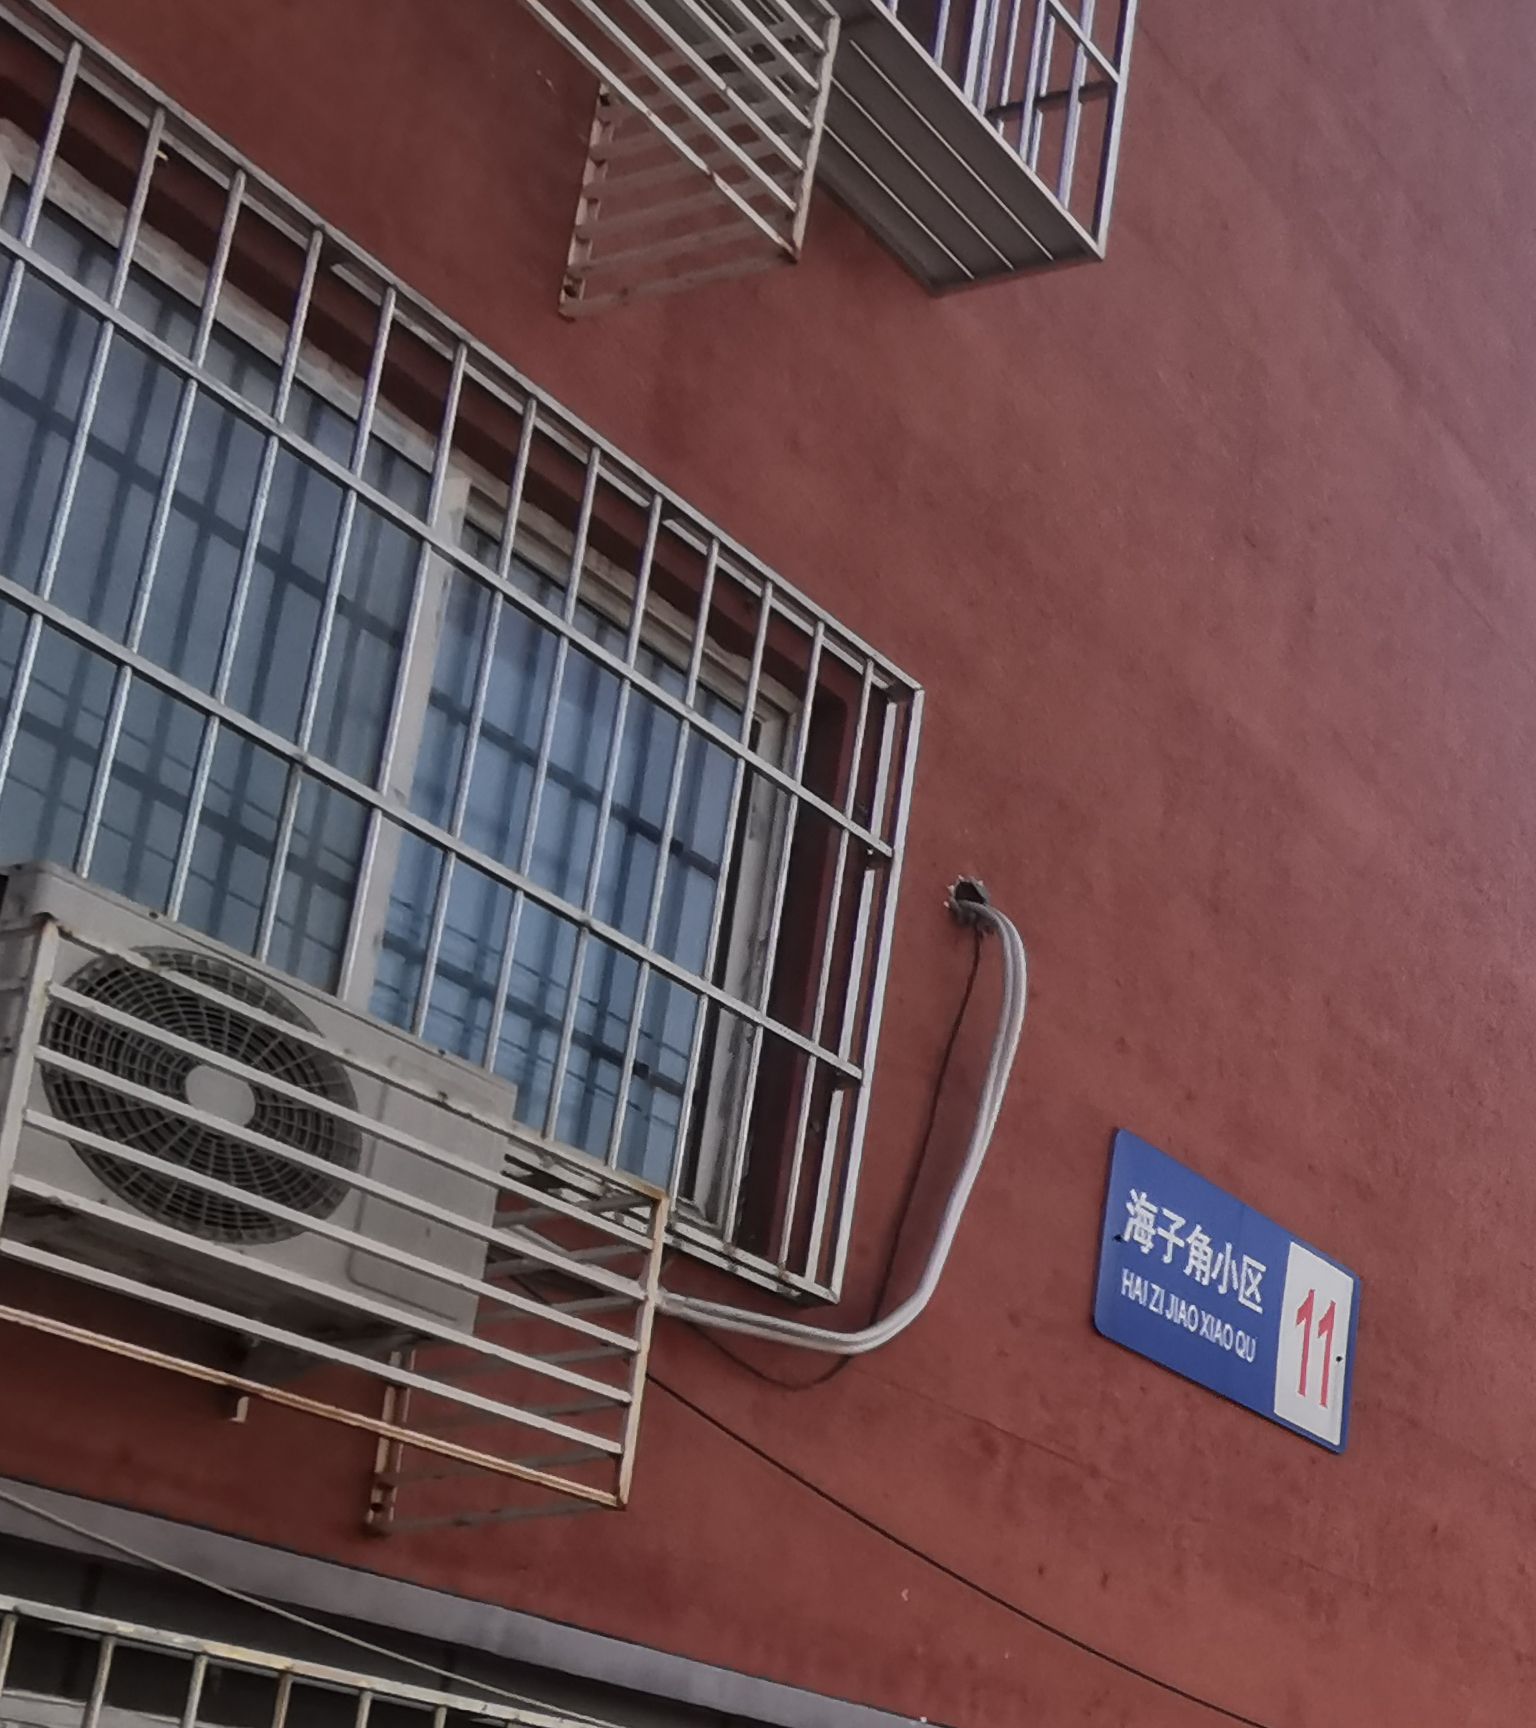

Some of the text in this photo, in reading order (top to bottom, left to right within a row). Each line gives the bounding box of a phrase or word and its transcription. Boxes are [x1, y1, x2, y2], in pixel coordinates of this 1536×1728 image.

[1122, 1187, 1267, 1314] 海子角小区
[1121, 1267, 1257, 1364] HAI ZI JIAO XIAO QU
[1296, 1287, 1337, 1409] 11
